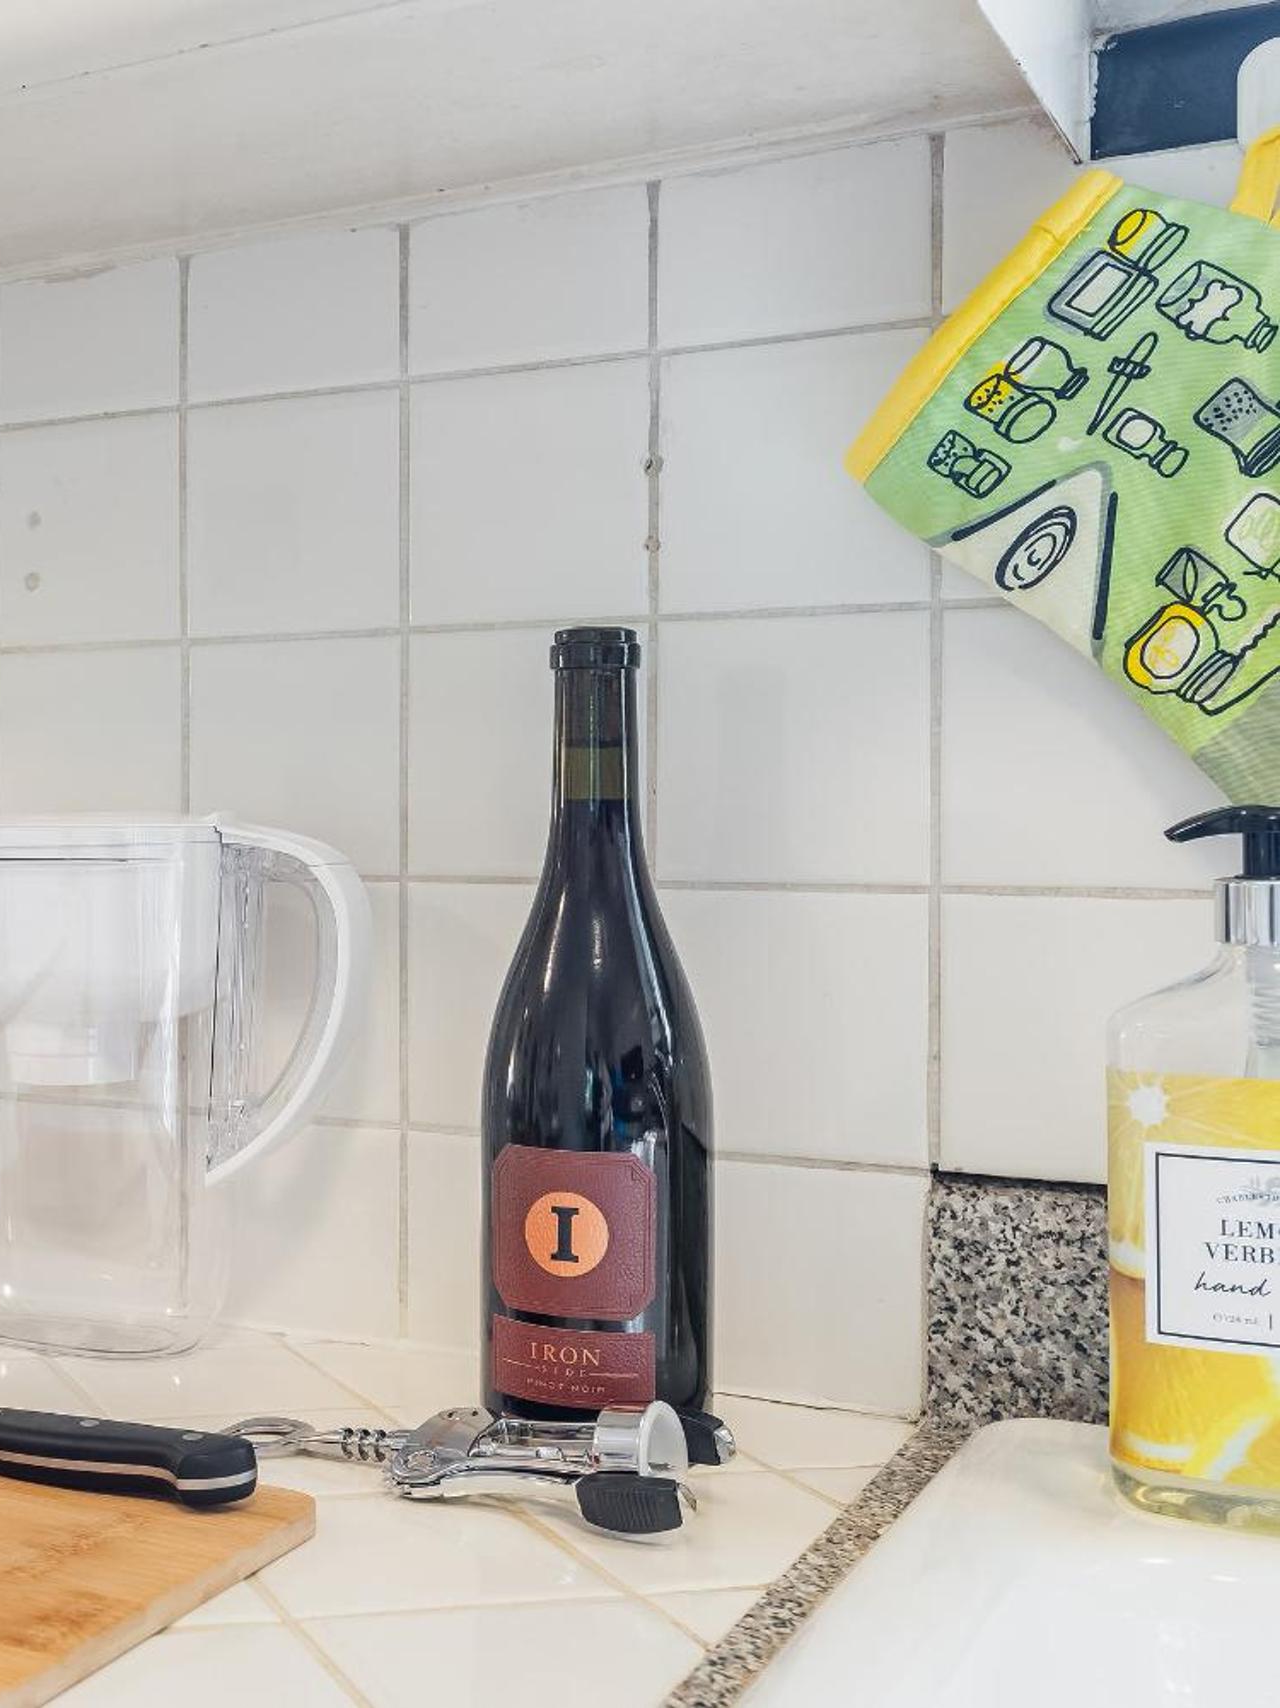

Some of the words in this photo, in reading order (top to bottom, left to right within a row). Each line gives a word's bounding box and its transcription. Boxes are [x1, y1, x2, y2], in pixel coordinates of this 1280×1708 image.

[550, 1205, 579, 1263] I
[1220, 1219, 1280, 1240] LEM
[1204, 1241, 1280, 1265] VERB
[1194, 1271, 1271, 1297] hand
[530, 1342, 601, 1366] IRON
[526, 1377, 565, 1390] PINOT
[570, 1385, 606, 1393] NOIR
